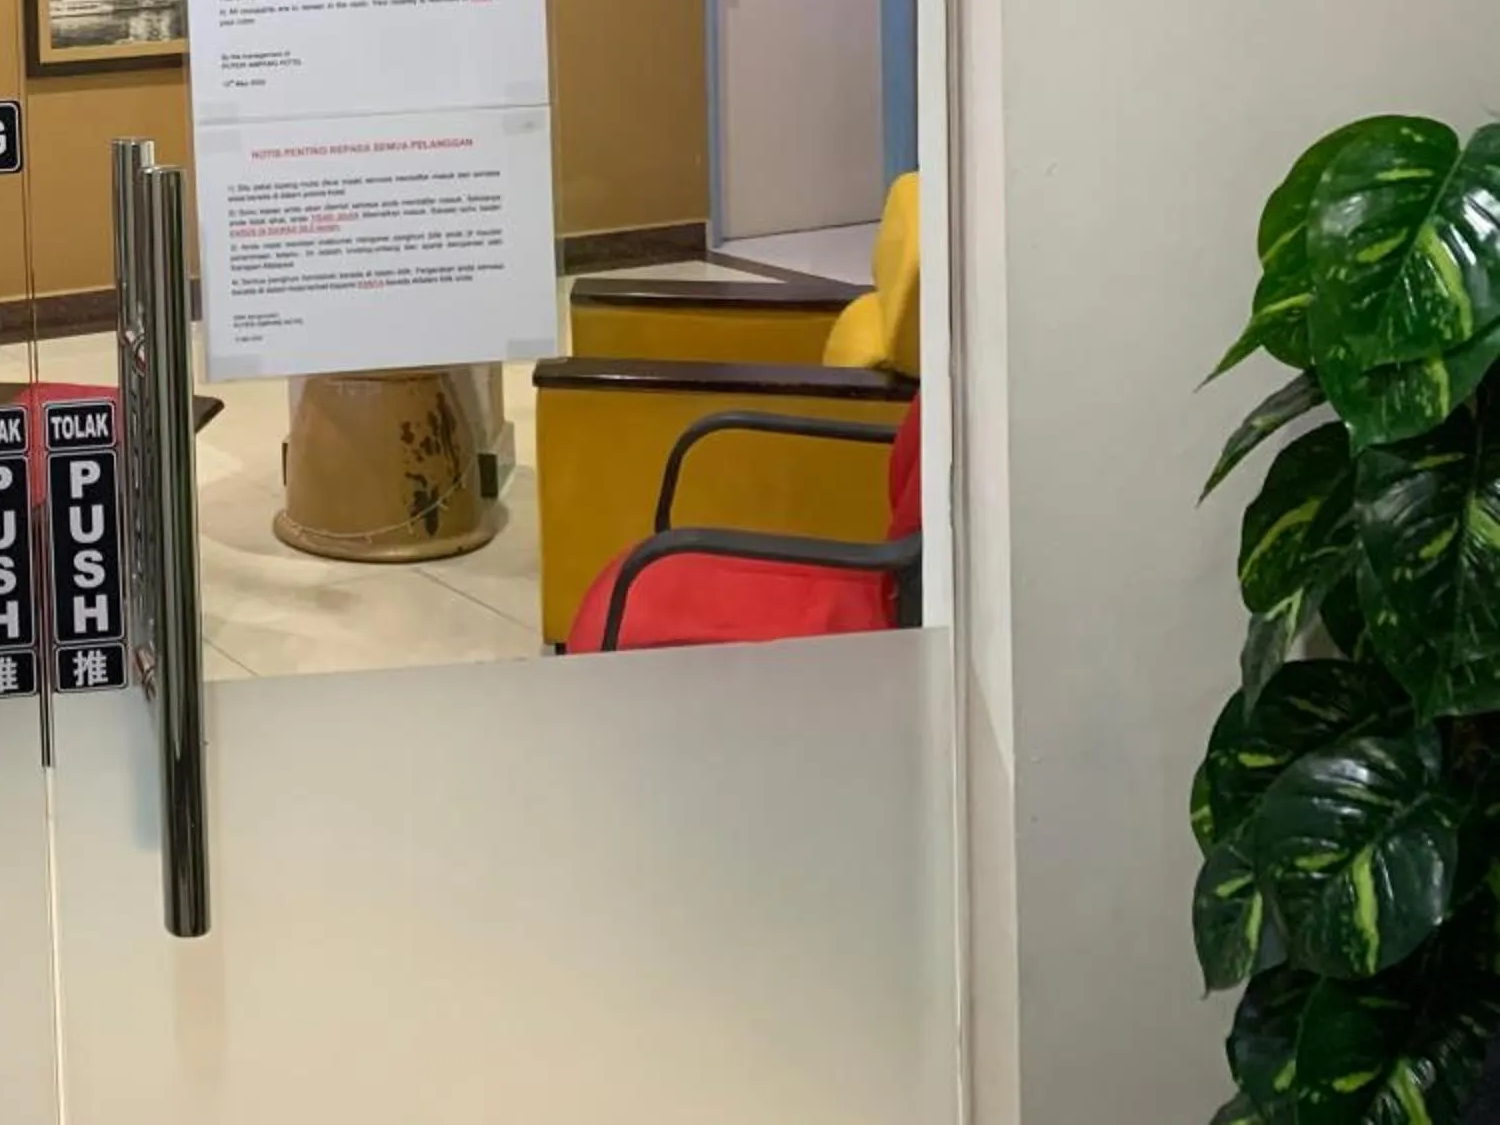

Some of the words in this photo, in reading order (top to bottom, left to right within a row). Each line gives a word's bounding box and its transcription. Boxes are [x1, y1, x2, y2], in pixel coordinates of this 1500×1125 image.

[50, 413, 109, 441] TOLAK
[68, 460, 110, 634] PUSH
[73, 650, 109, 687] 推
